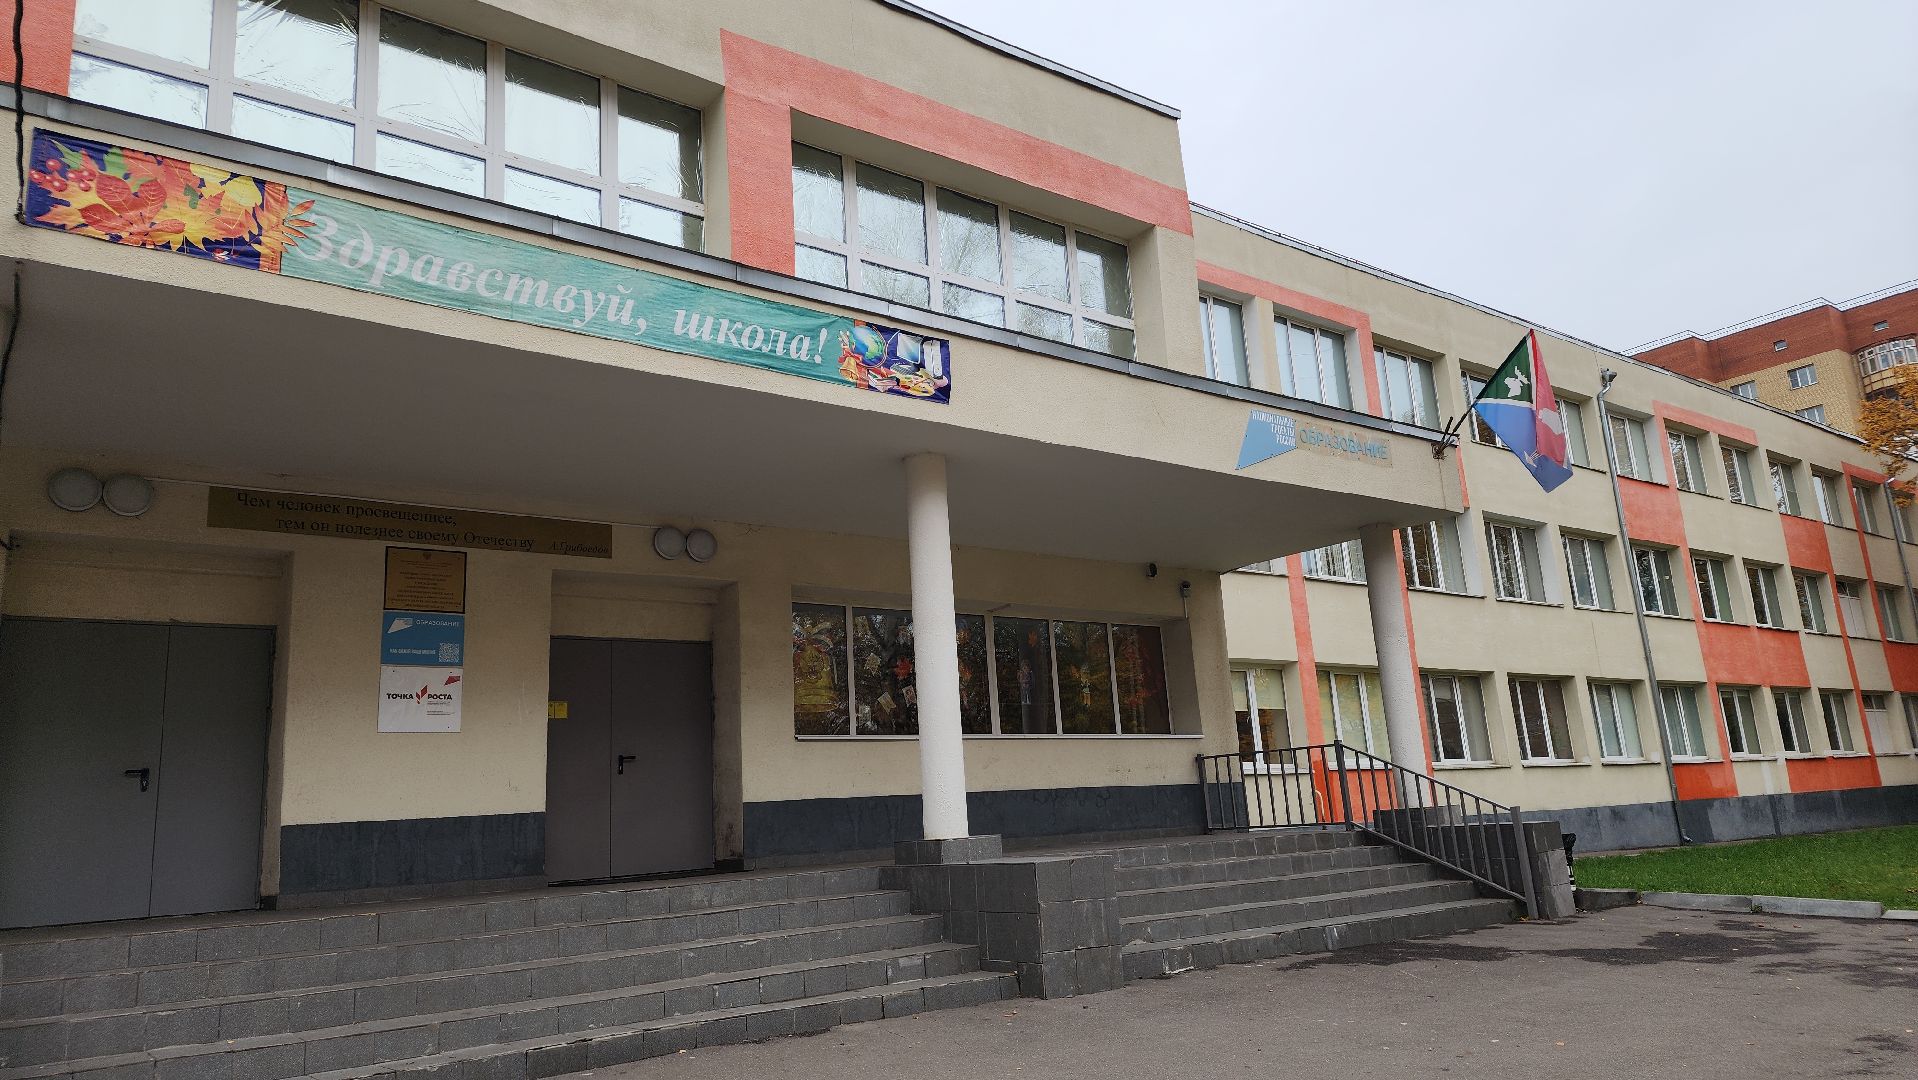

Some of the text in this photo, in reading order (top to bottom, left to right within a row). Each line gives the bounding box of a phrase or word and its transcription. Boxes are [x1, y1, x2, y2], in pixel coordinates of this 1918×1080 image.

[298, 212, 829, 364] Здравствуй, школа!
[1300, 429, 1388, 460] ОБРАЗОВАНИЕ
[237, 492, 457, 526] Чем человек просвещеннее,
[277, 518, 305, 531] тем
[310, 520, 330, 532] он
[335, 523, 404, 538] полезнее
[408, 529, 459, 544] своему
[464, 531, 536, 551] Отечеству
